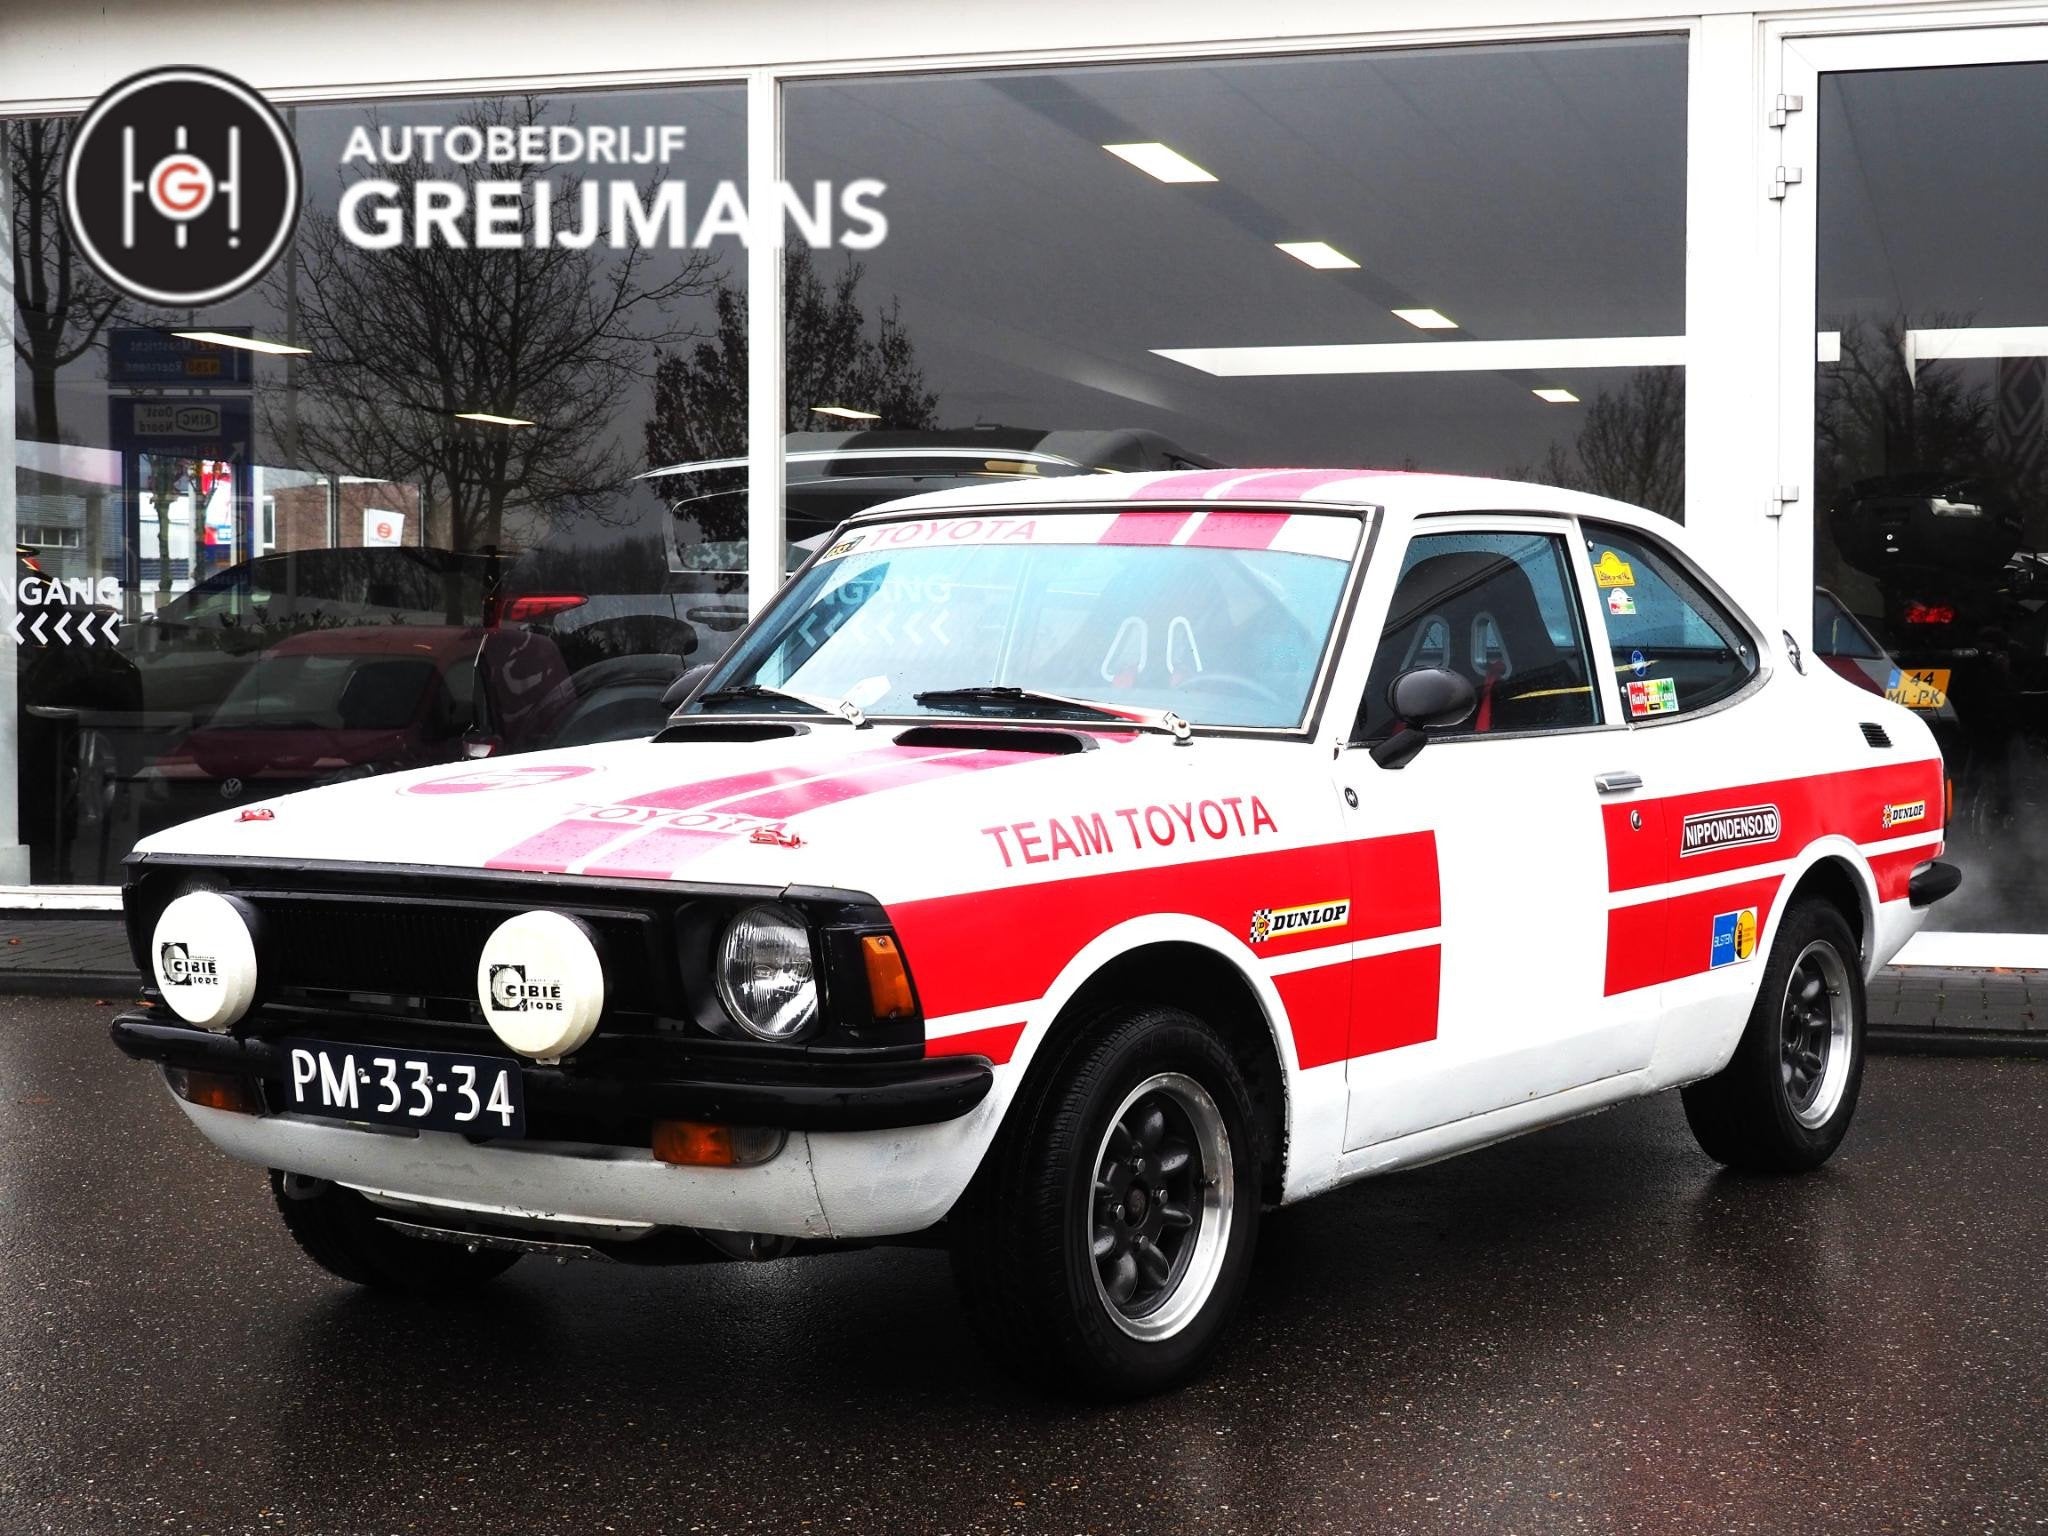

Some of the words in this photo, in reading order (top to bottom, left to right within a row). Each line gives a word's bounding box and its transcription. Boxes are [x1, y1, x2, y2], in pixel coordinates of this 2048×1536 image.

[869, 519, 1037, 547] TOYOTA
[1911, 671, 1935, 686] 44
[563, 803, 789, 834] TOYOTA
[1892, 804, 1924, 821] DUNLOP
[981, 811, 1114, 868] TEAM
[1115, 795, 1279, 849] TOYOTA
[1685, 815, 1764, 847] NIPPONDENSO
[1272, 904, 1347, 931] DUNLOP
[193, 976, 218, 985] IODE
[530, 1001, 563, 1011] IODE
[291, 1048, 515, 1127] PM-33-34
